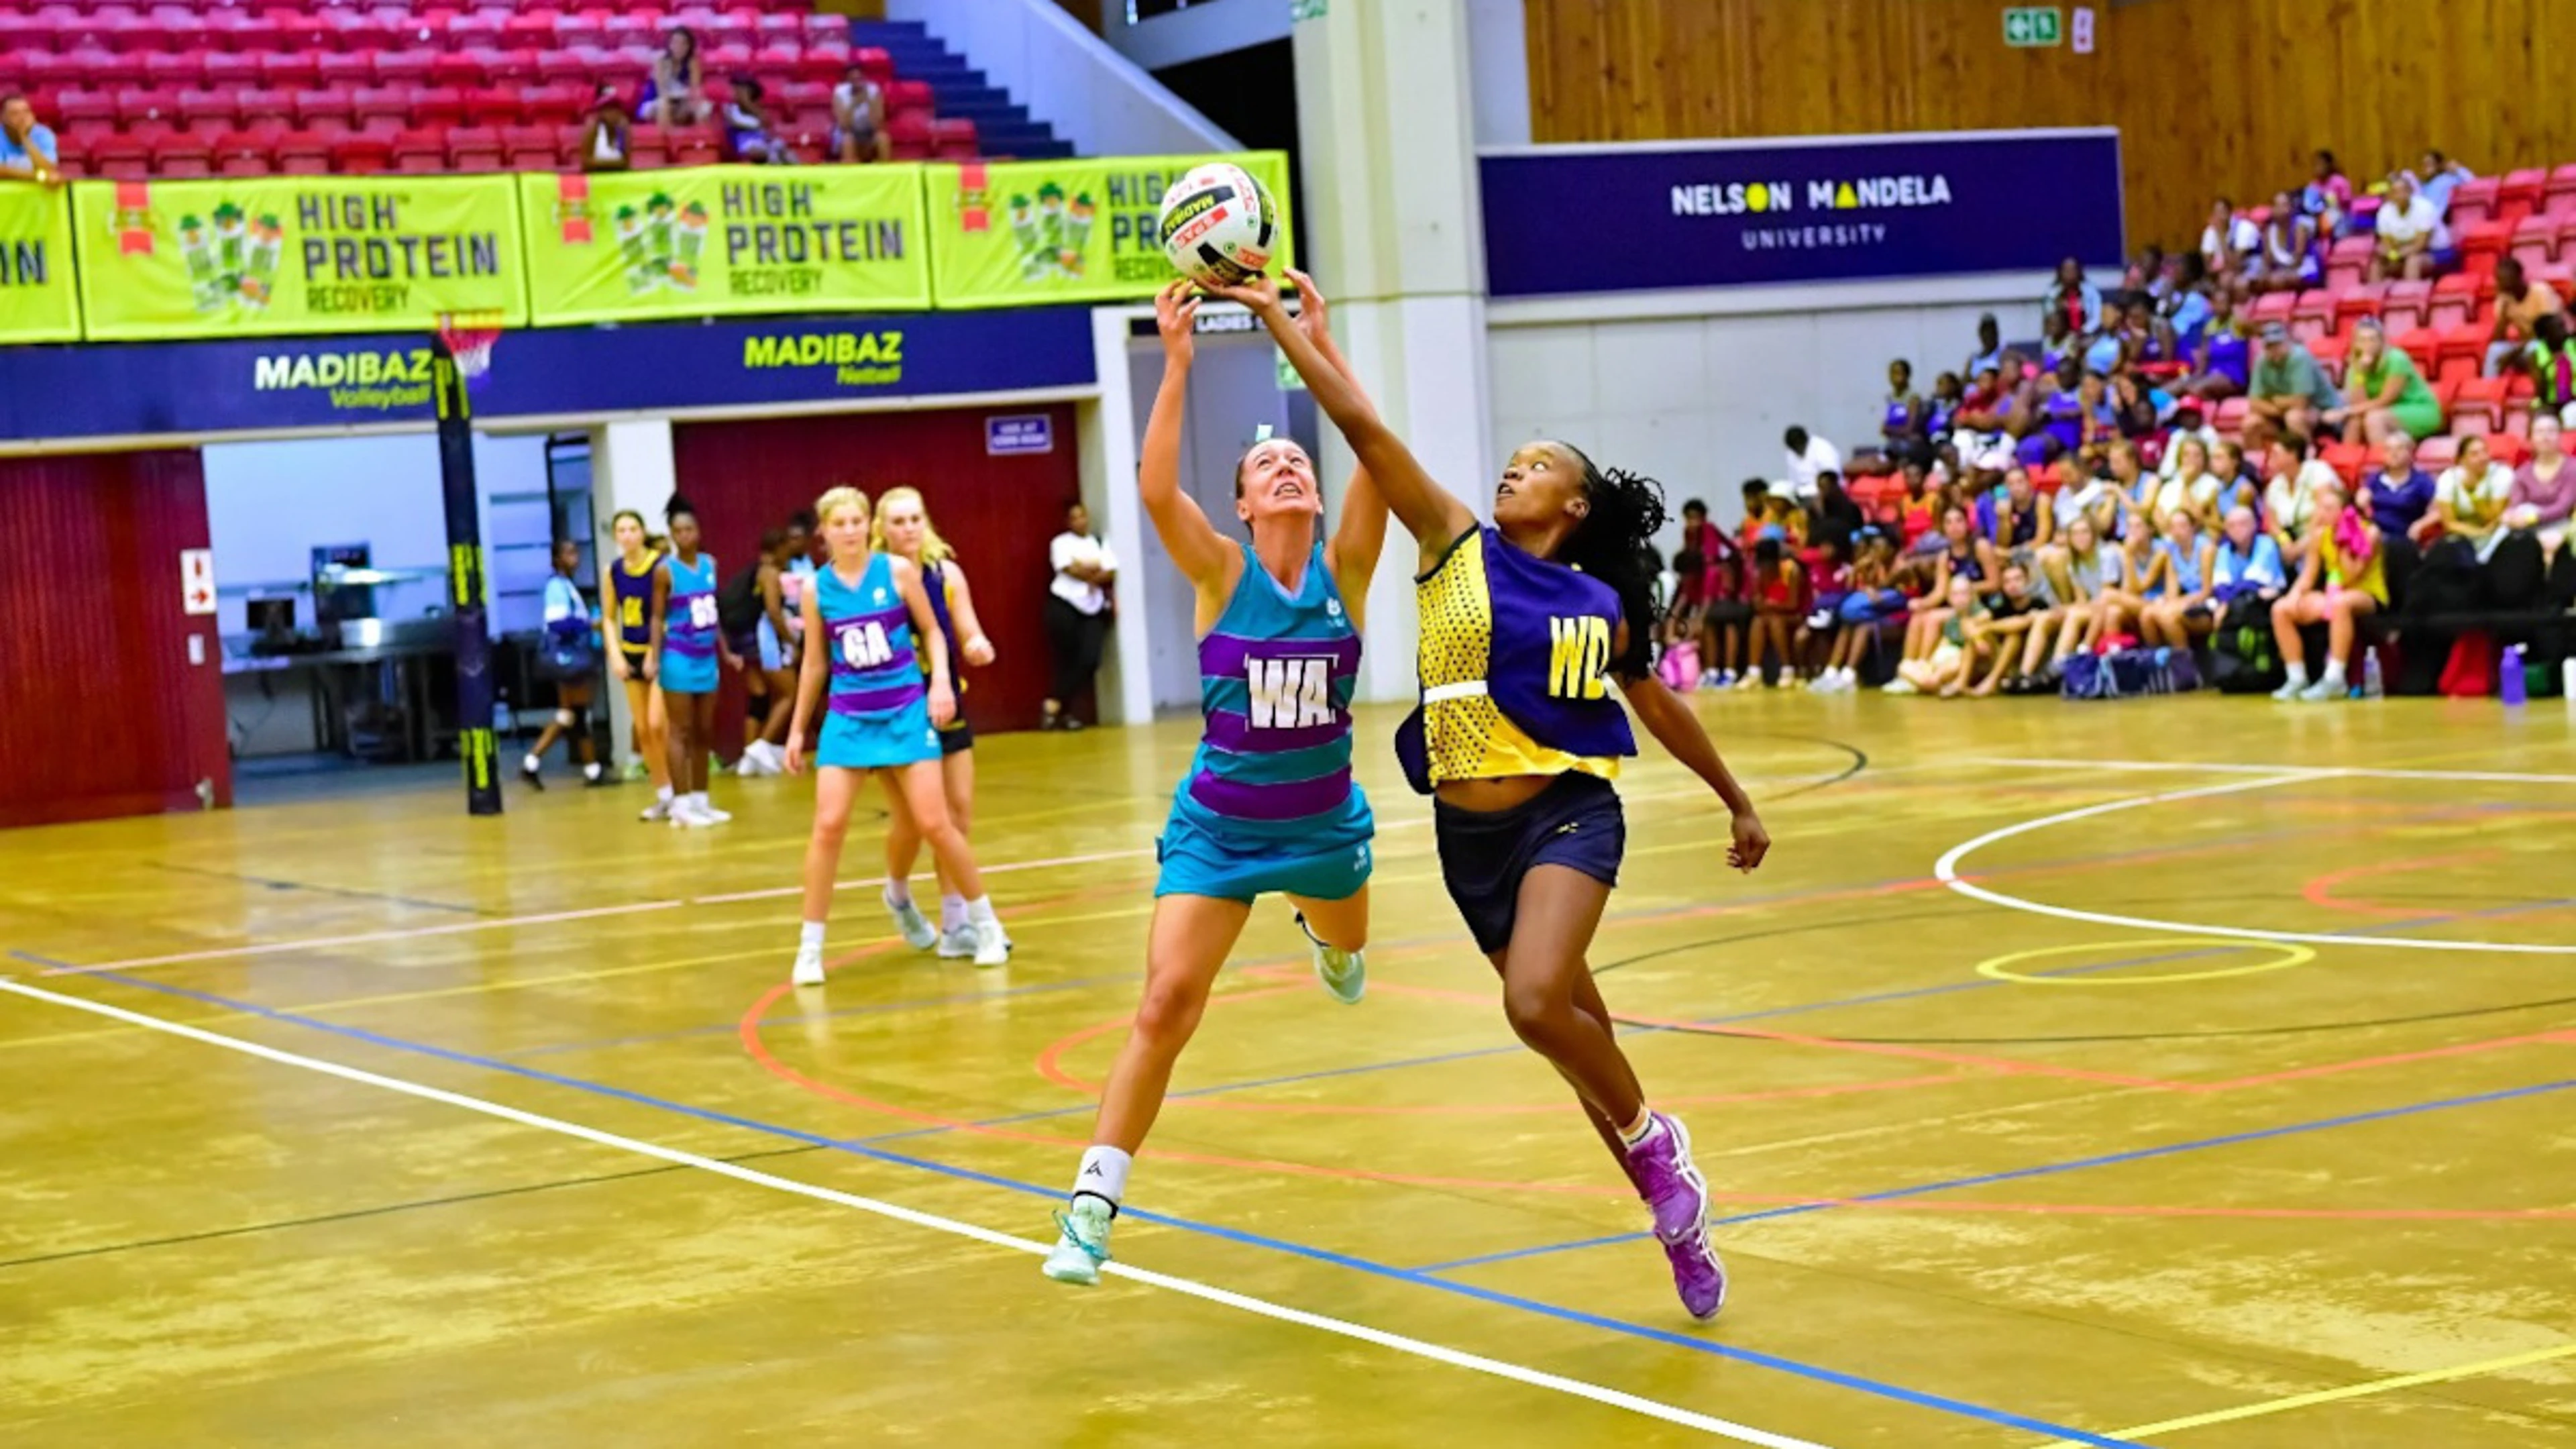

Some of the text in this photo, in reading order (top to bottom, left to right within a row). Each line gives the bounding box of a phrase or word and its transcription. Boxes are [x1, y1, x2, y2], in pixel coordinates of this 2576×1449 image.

[298, 194, 398, 230] HIGH
[721, 182, 812, 217] HIGH
[1671, 174, 1951, 216] NELSON MANDELA
[727, 219, 904, 264] PROTEIN
[1741, 223, 1886, 250] UNIVERSITY
[303, 232, 498, 281] PROTEIN
[306, 286, 409, 313] RECOVERY
[729, 270, 823, 296] RECOVERY
[1195, 315, 1252, 333] LADIES
[254, 348, 433, 390] MADIBAZ
[743, 330, 903, 369] MADIBAZ
[329, 383, 432, 411] Volleyball
[843, 621, 894, 669] GA
[1548, 614, 1610, 700] WD
[1248, 659, 1331, 729] WA
